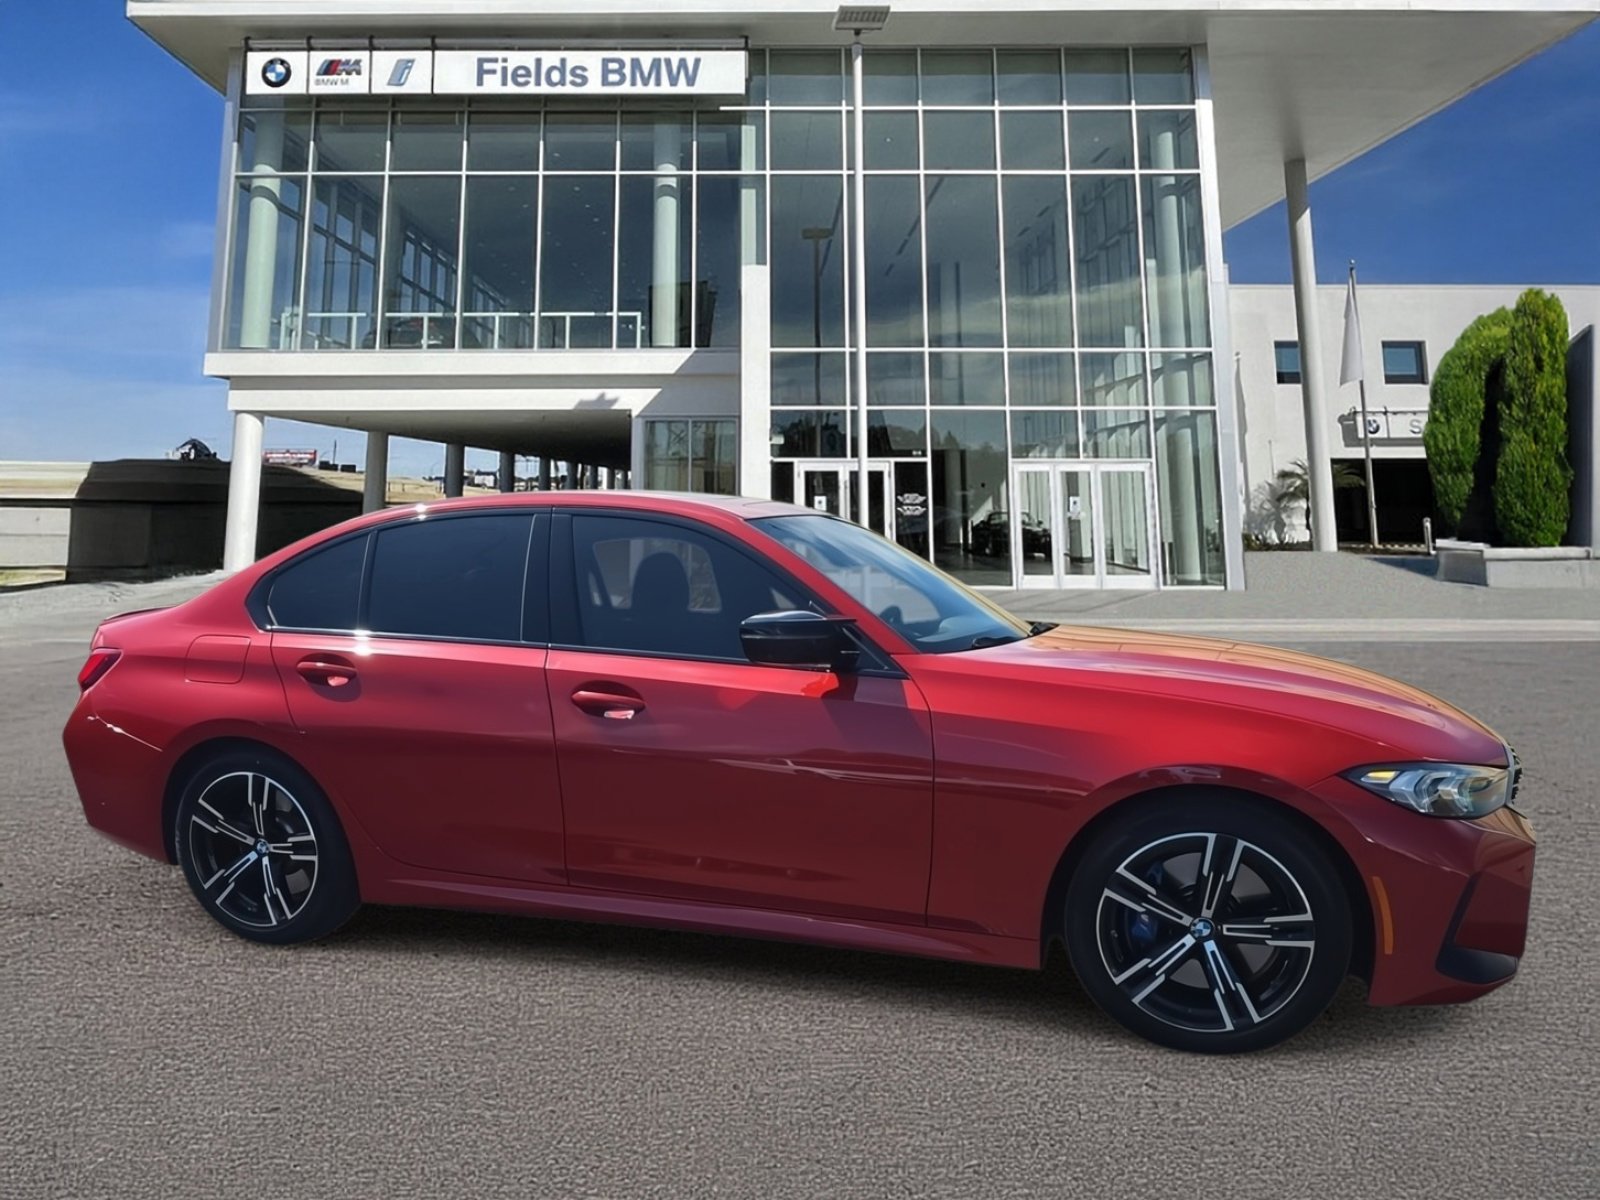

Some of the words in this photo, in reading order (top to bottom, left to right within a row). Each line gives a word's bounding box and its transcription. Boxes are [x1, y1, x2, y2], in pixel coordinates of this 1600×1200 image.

[476, 57, 589, 87] Fields
[601, 57, 701, 87] BMW
[1409, 419, 1423, 435] S
